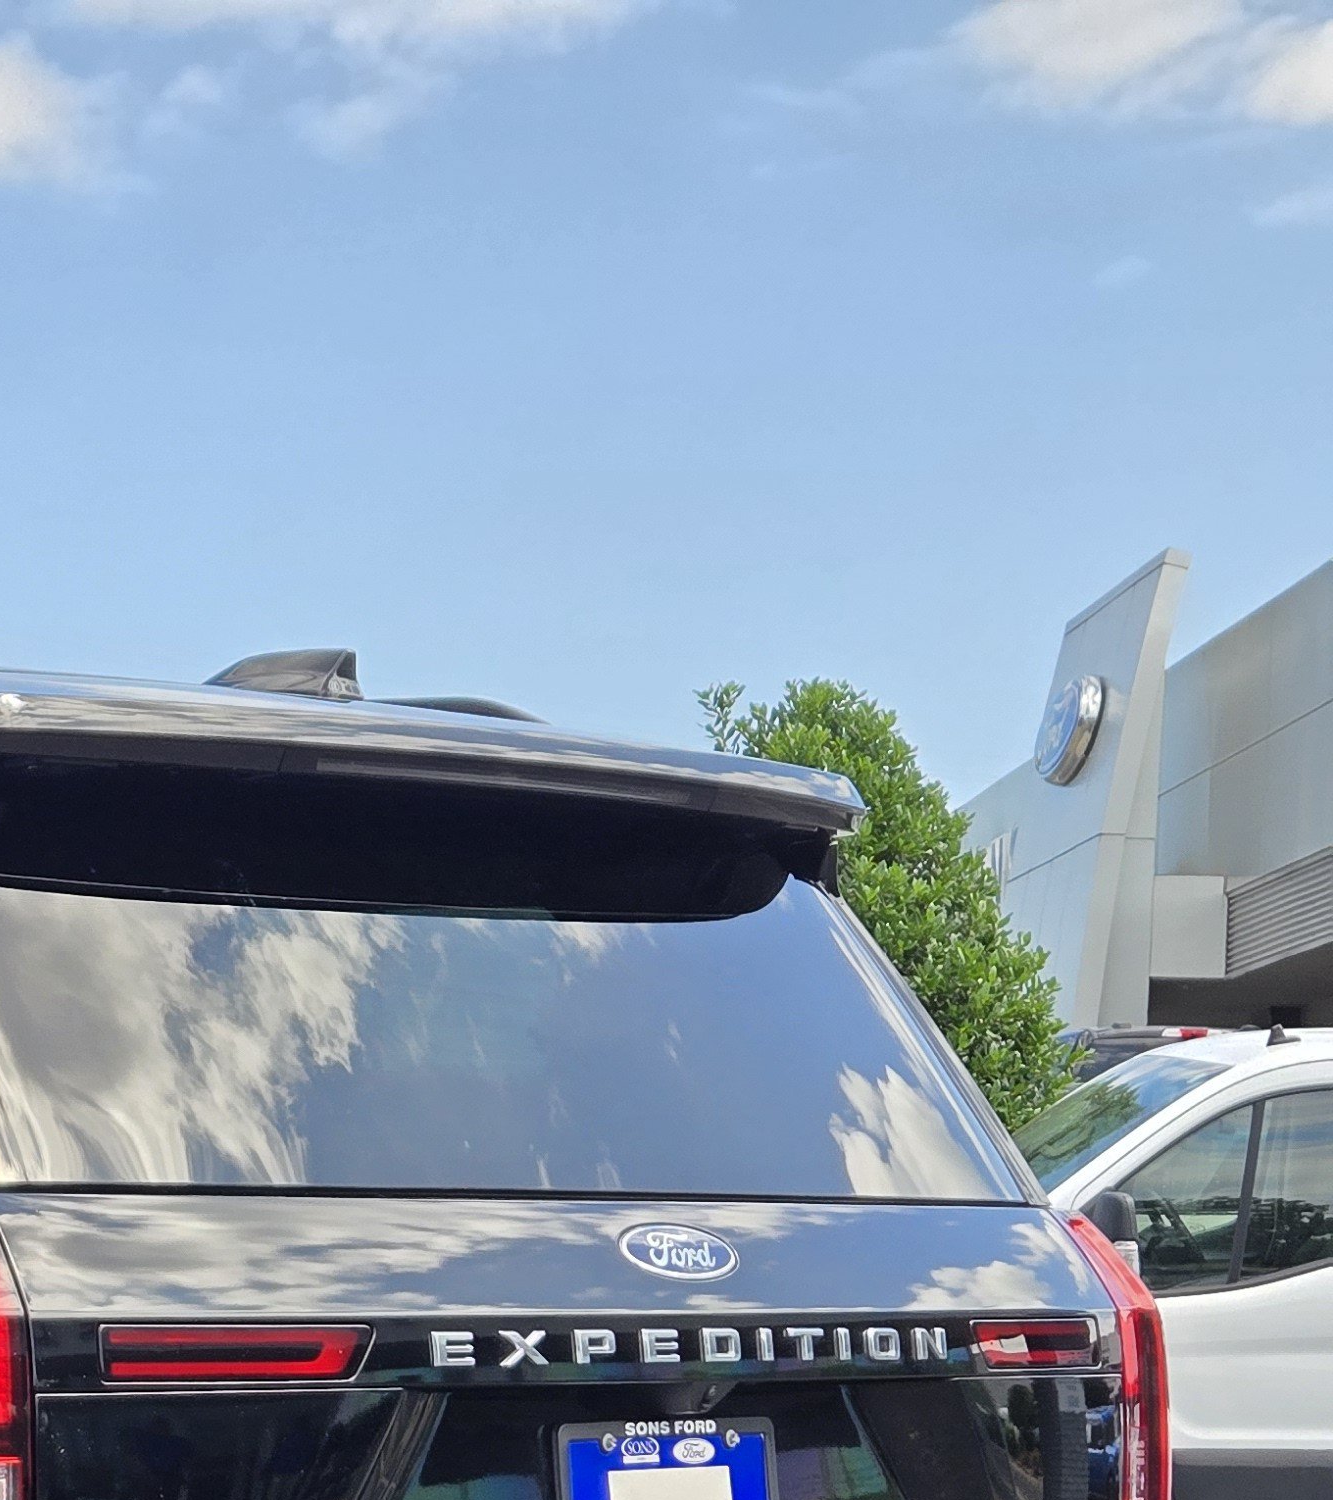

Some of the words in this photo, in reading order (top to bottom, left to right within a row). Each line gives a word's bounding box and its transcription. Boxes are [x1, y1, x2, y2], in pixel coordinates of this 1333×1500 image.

[647, 1231, 717, 1268] Ford
[429, 1326, 948, 1368] EXPEDITION
[624, 1421, 670, 1436] SONS
[674, 1419, 717, 1434] FORD
[682, 1443, 706, 1458] Ford
